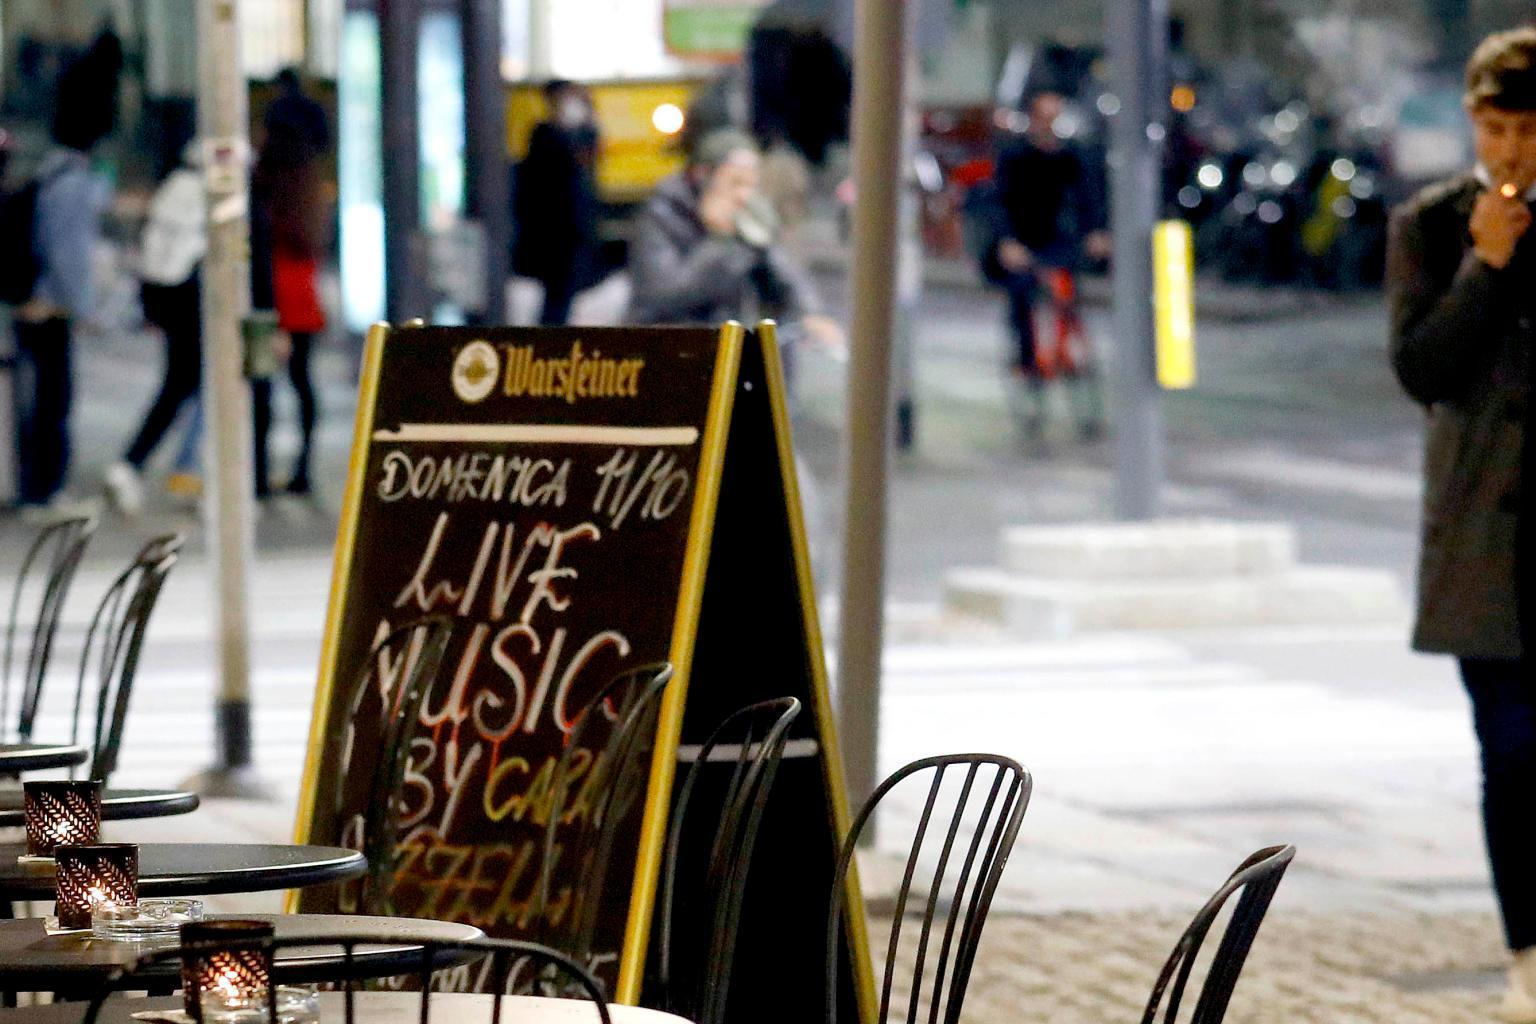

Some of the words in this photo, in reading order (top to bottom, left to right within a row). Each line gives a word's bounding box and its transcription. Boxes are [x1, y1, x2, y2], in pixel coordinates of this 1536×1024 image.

[503, 338, 646, 404] Warsteiner
[377, 450, 573, 506] DOMENICA
[595, 449, 691, 529] 11/10
[393, 511, 601, 625] LIVE
[353, 619, 631, 737] MUSIC
[388, 737, 482, 840] BY
